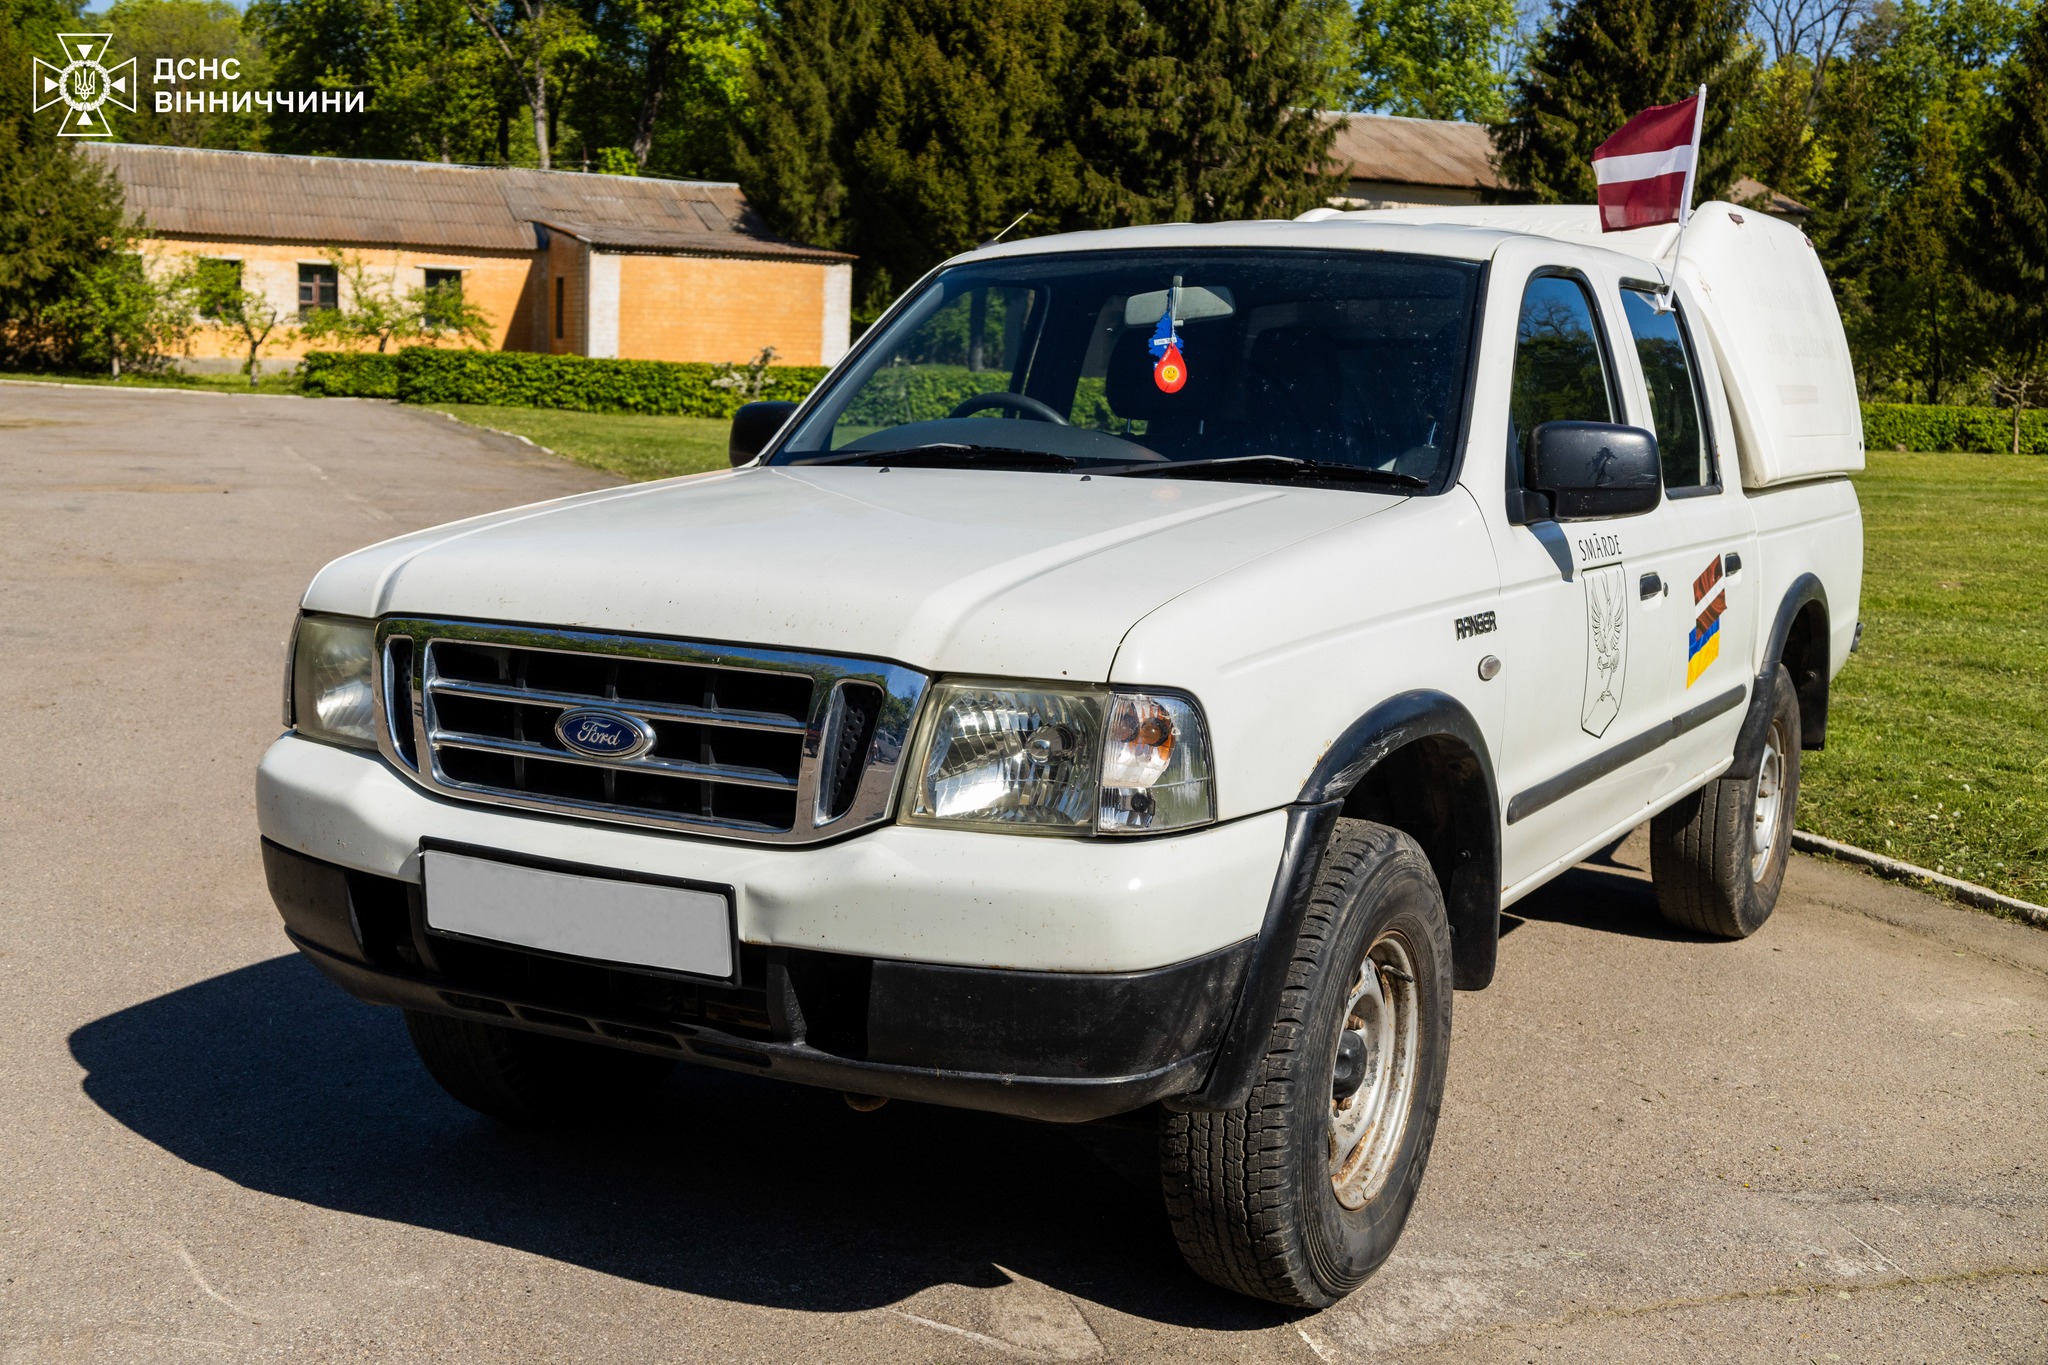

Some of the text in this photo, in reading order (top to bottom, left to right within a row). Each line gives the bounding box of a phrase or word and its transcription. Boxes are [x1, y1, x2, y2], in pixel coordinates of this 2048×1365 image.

[1578, 532, 1622, 561] SMĀRDE
[1454, 610, 1497, 641] RANGER
[577, 720, 621, 746] Ford
